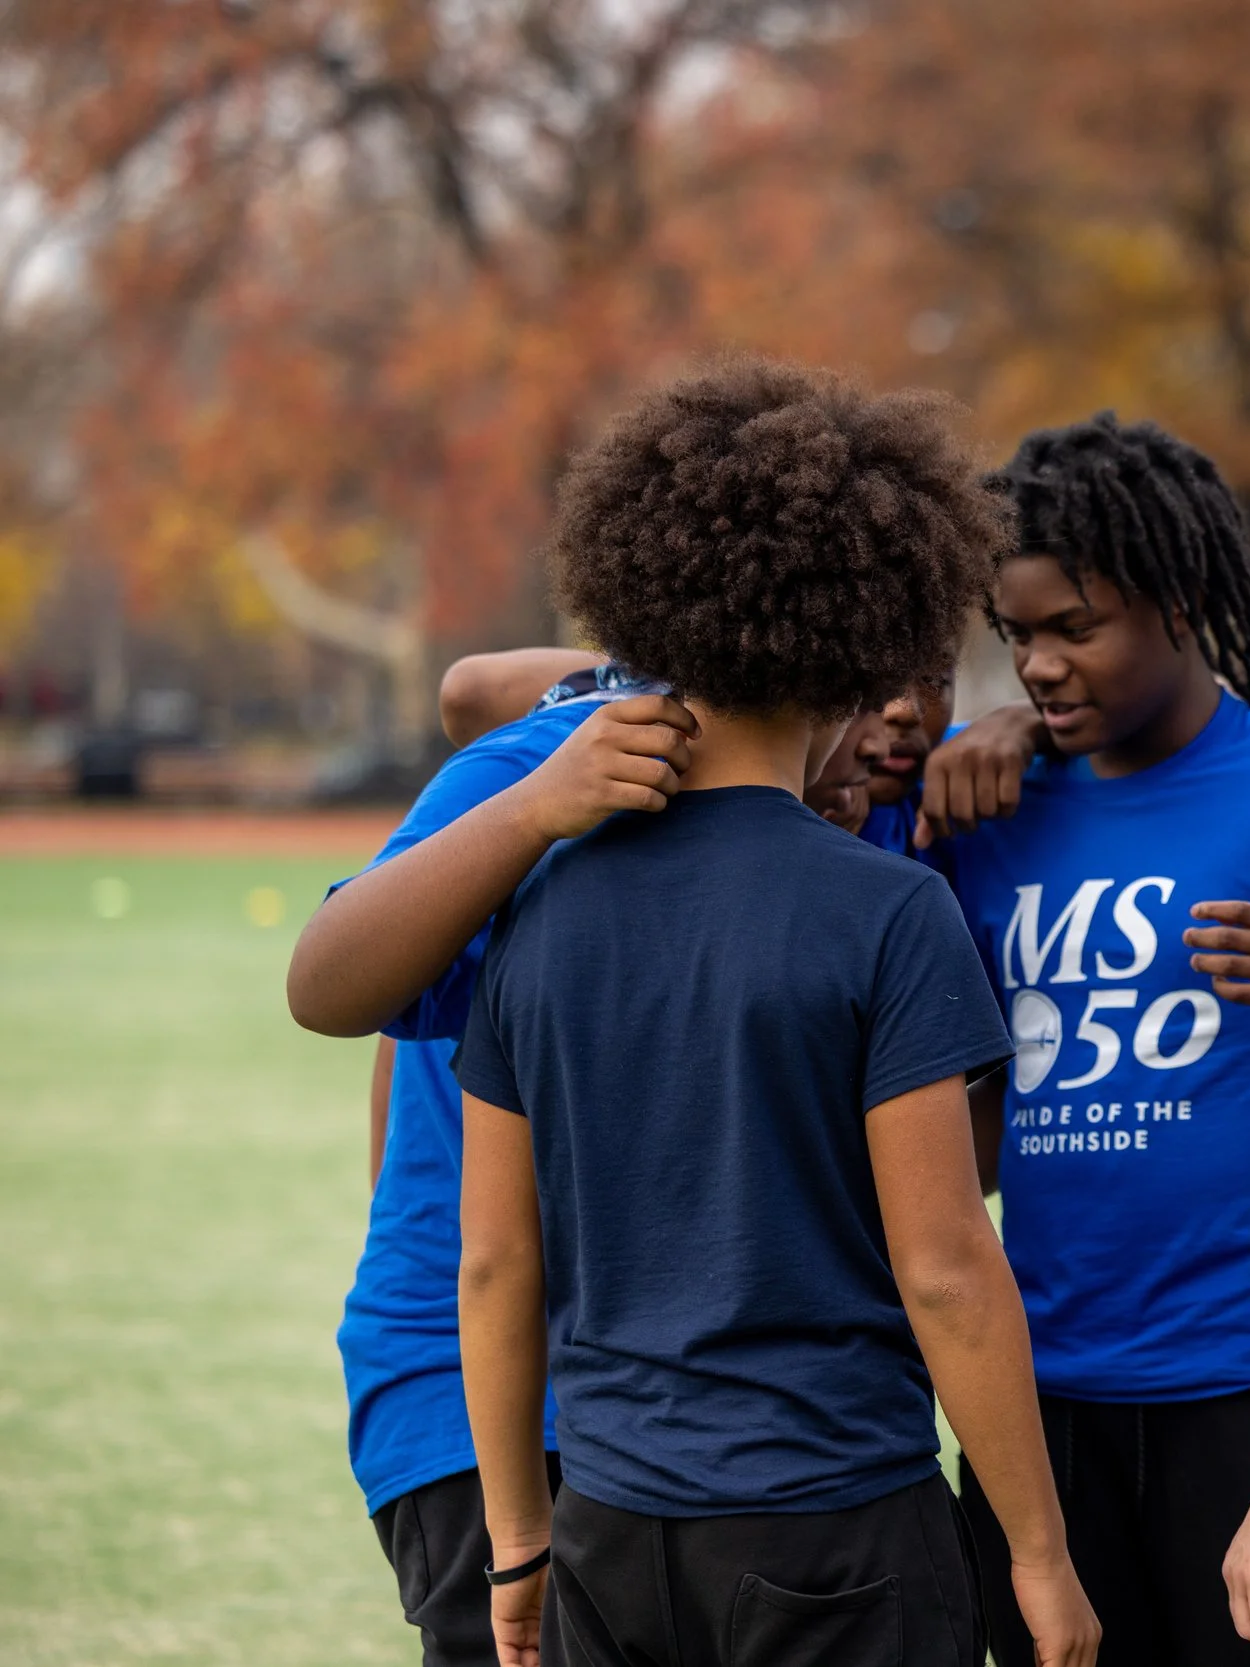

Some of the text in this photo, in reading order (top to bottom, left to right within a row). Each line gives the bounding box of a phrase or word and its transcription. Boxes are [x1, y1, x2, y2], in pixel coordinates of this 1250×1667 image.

[1003, 876, 1176, 988] MS
[1057, 989, 1222, 1090] 50
[1020, 1129, 1149, 1155] SOUTHSIDE
[1086, 1103, 1123, 1124] OF
[1134, 1100, 1193, 1122] THE
